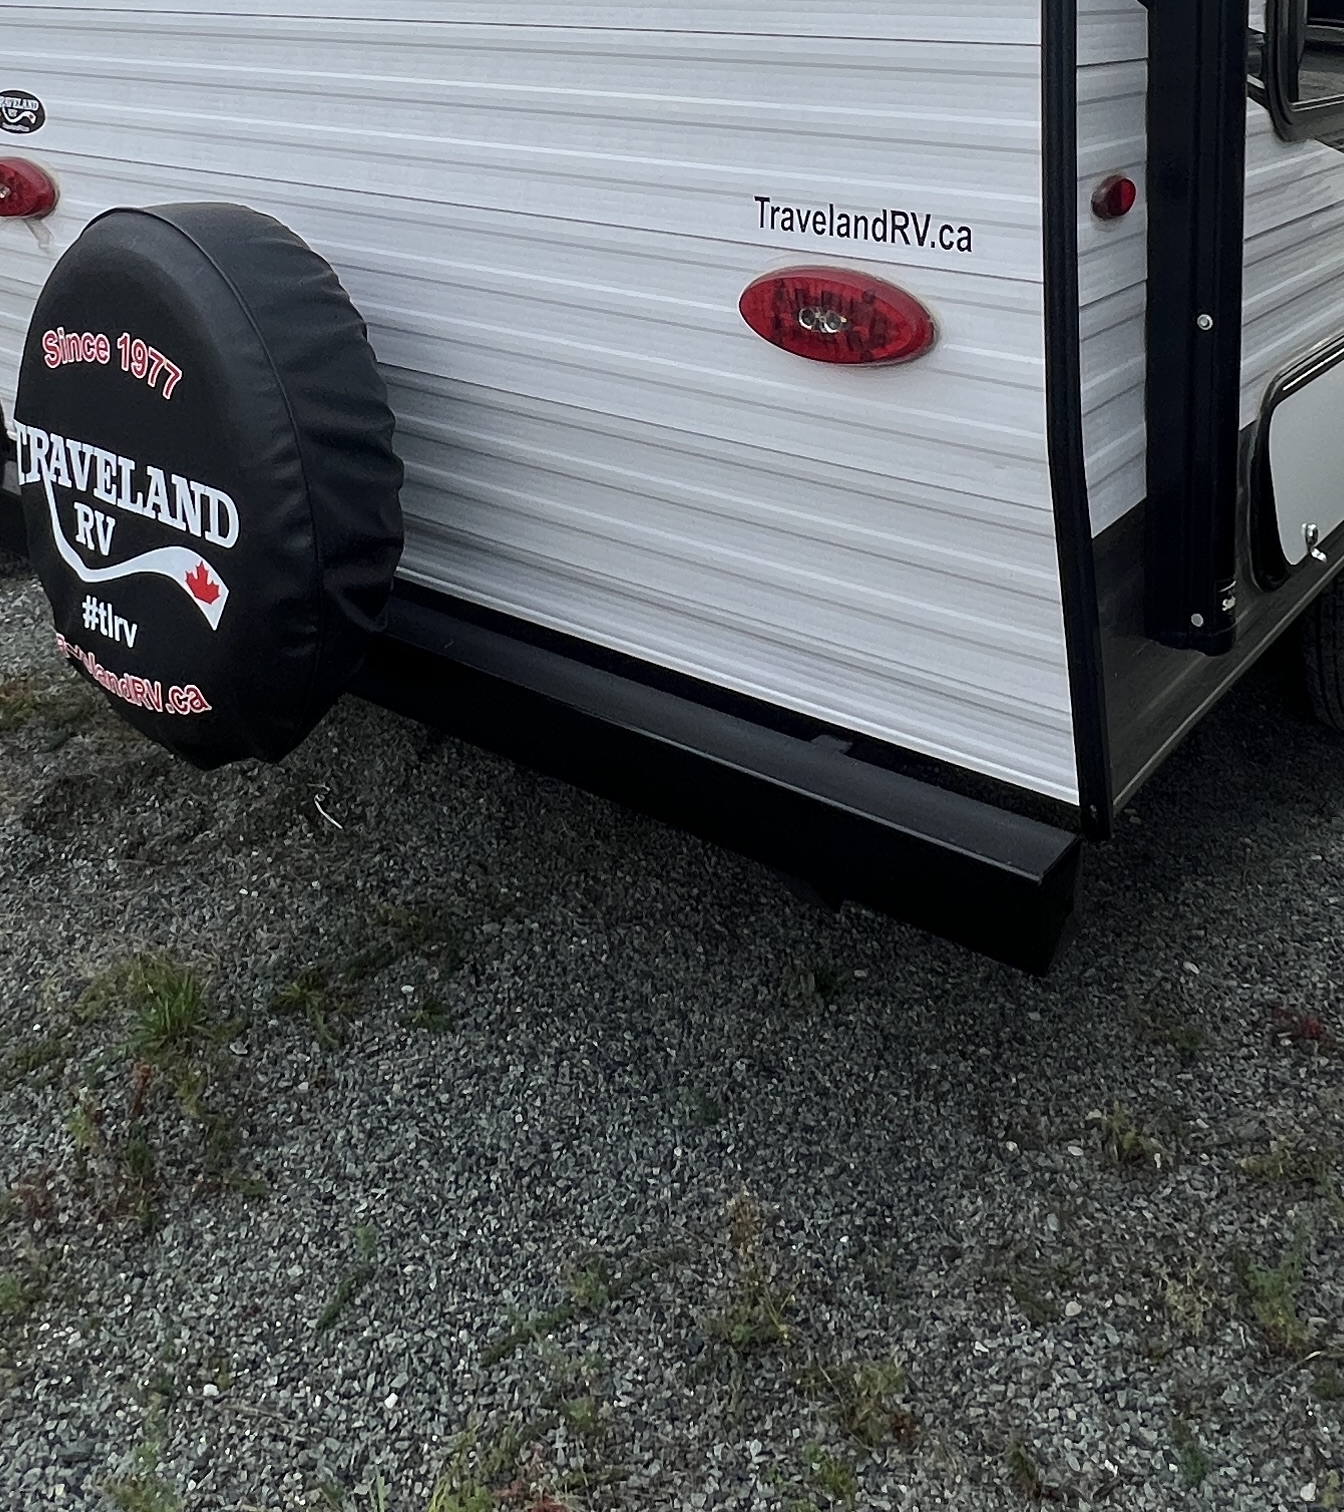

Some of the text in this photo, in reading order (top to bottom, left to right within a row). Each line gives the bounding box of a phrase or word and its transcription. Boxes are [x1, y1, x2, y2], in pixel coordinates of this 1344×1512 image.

[754, 195, 973, 253] TravelandRV.ca
[42, 327, 183, 400] Since 1977
[13, 419, 240, 549] TRAVELAND
[73, 501, 116, 556] RV
